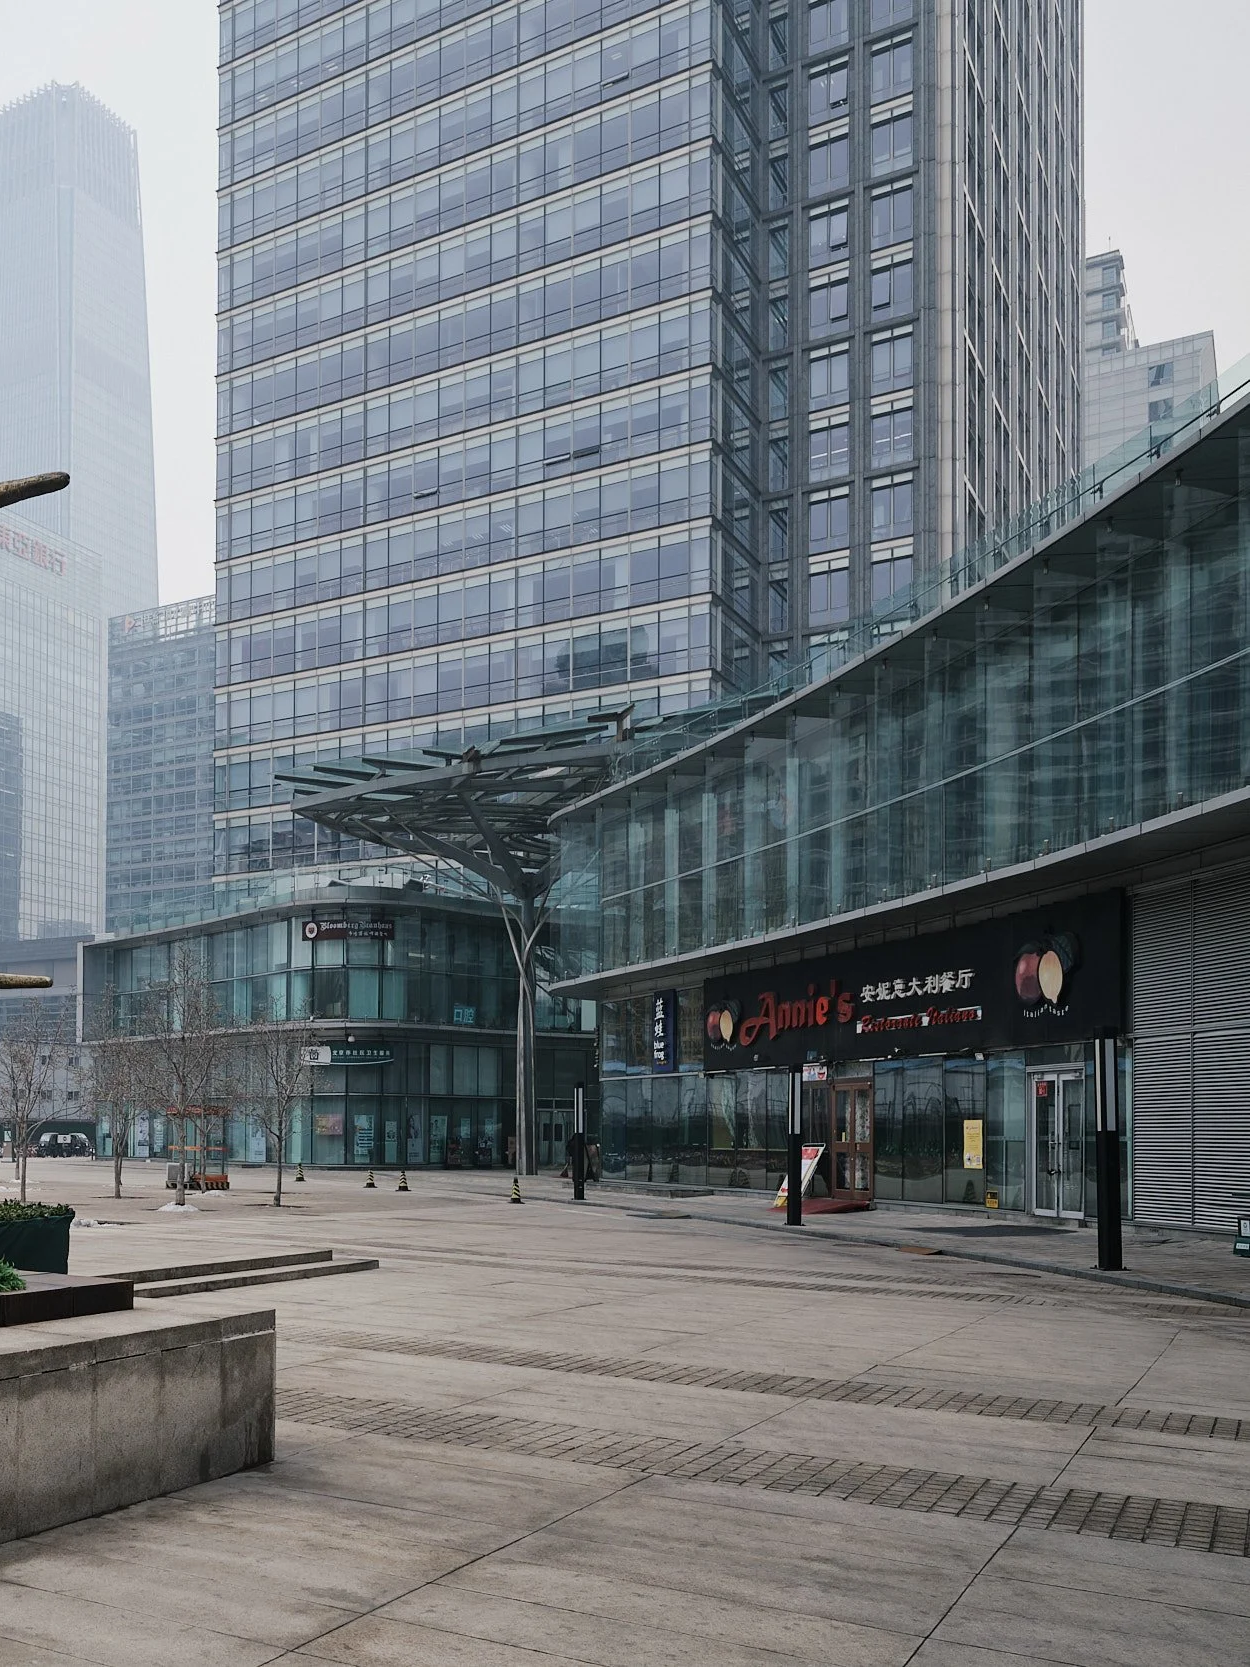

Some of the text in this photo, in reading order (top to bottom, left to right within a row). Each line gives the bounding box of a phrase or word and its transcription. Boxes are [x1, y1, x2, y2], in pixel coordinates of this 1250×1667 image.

[319, 921, 358, 932] Bloomberg
[859, 968, 976, 1003] 安妮意大利餐厅
[453, 1008, 475, 1023] 口腔
[739, 978, 855, 1046] Annie's
[1023, 1003, 1069, 1018] Italian taste
[653, 1040, 665, 1050] blue
[653, 1050, 665, 1061] frog
